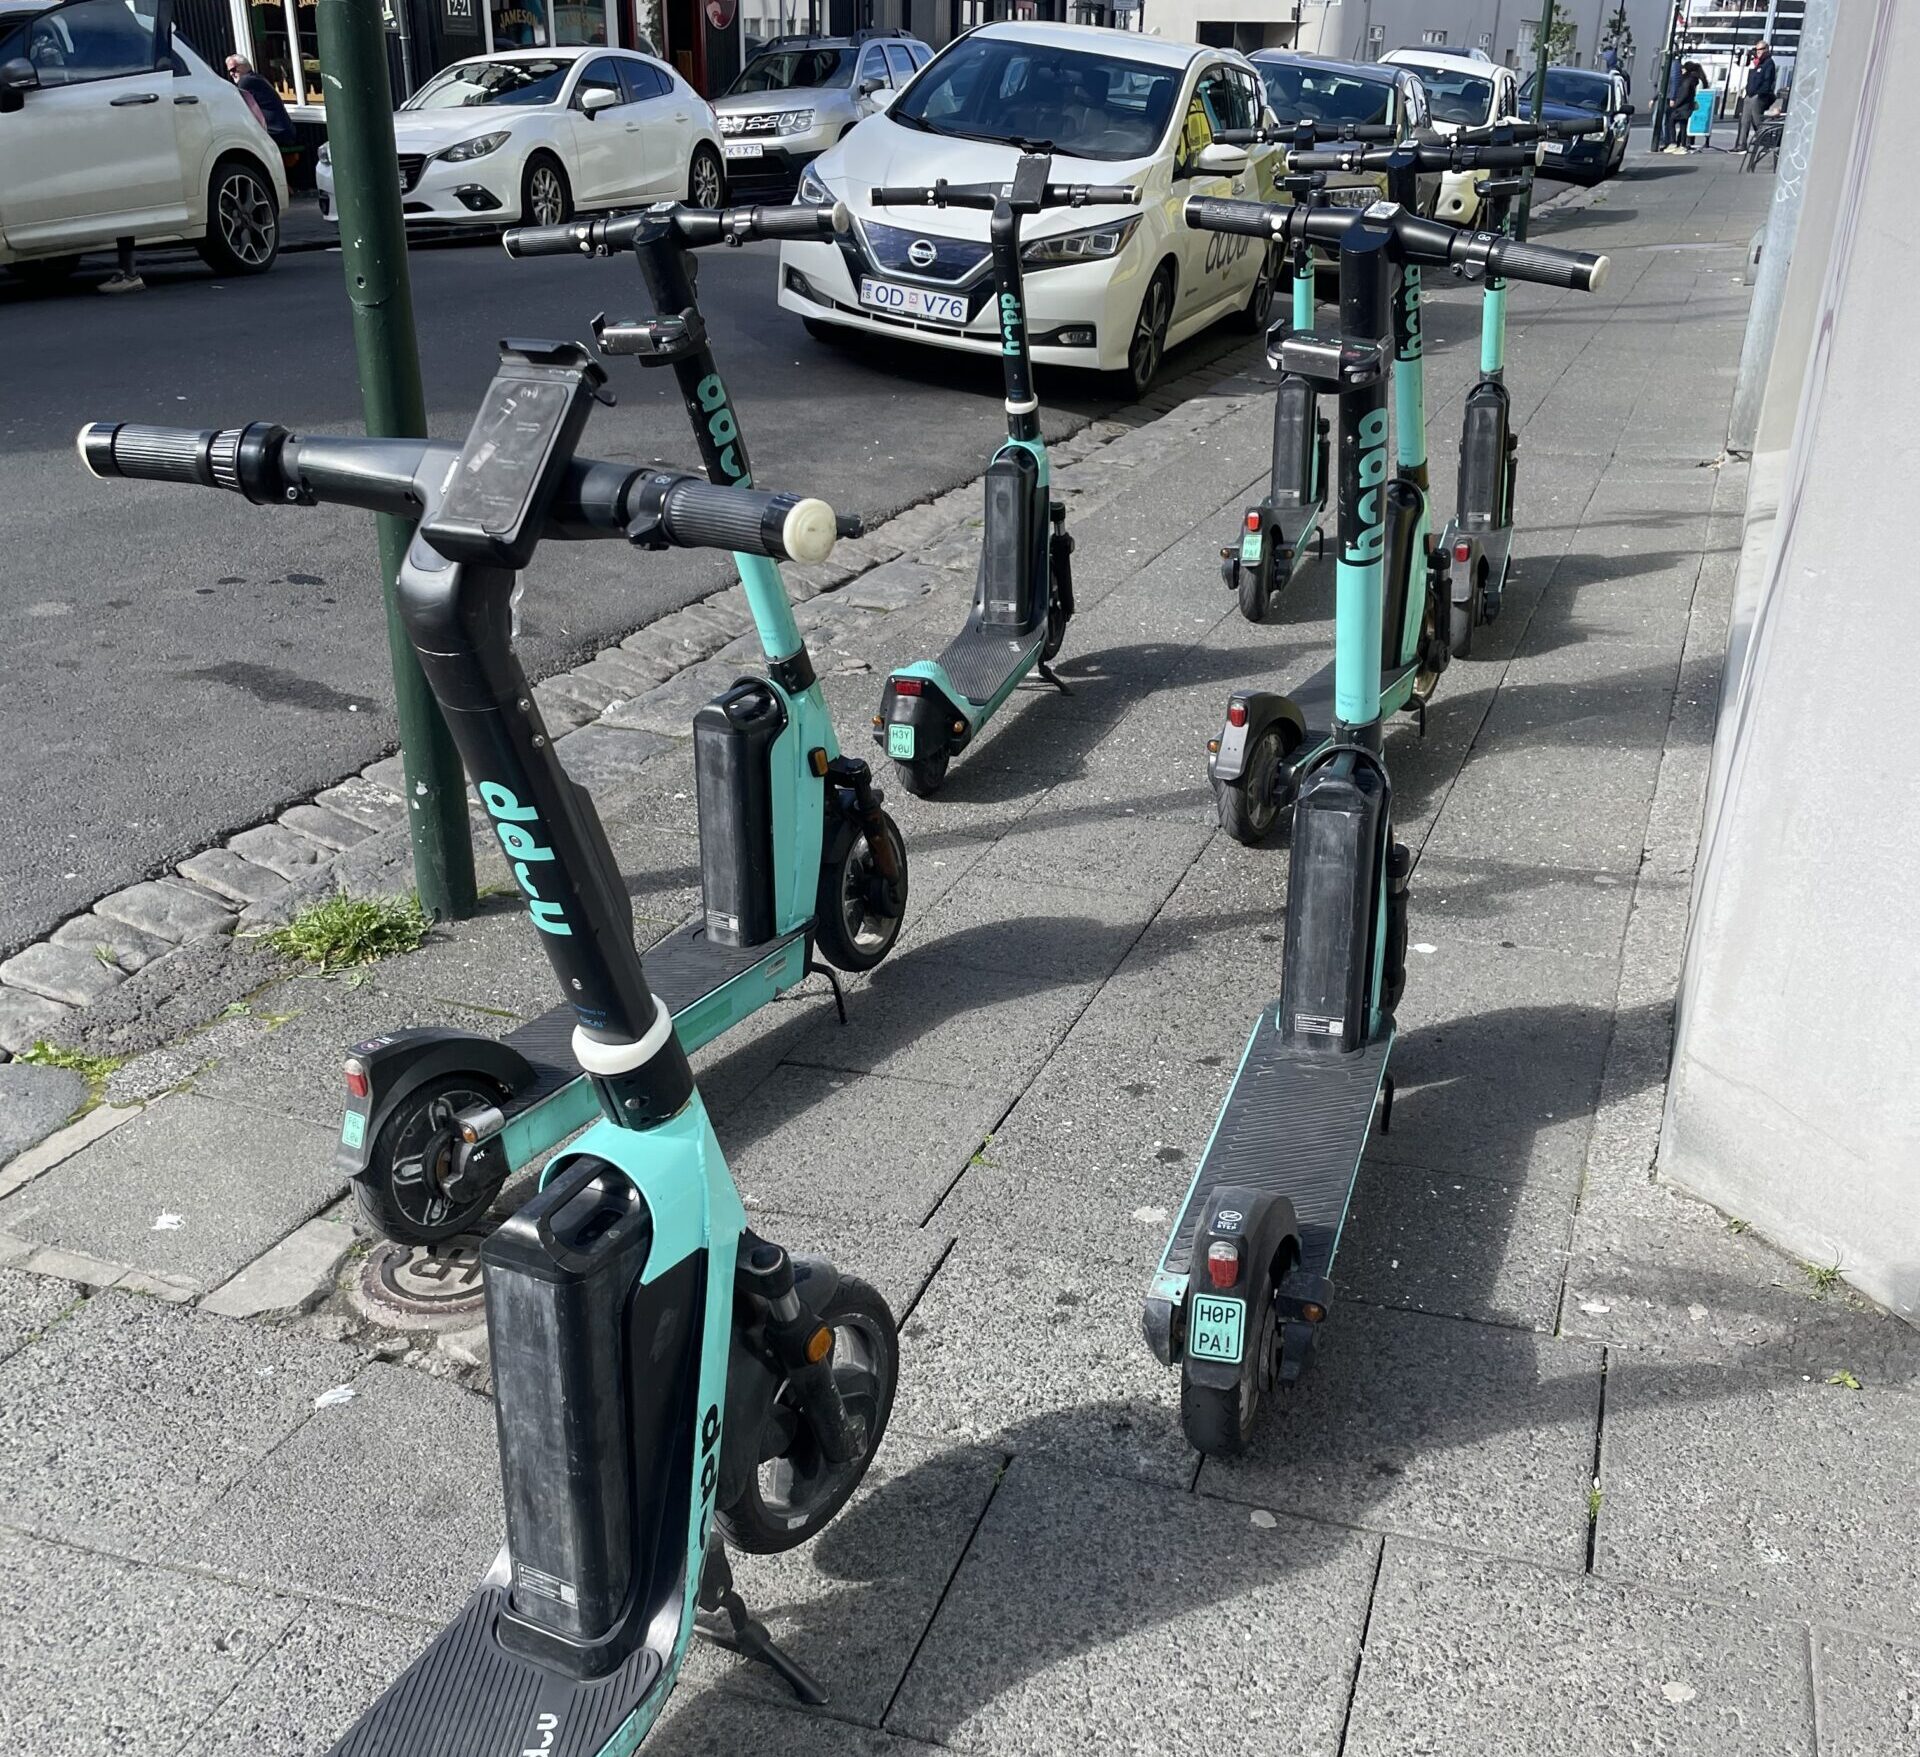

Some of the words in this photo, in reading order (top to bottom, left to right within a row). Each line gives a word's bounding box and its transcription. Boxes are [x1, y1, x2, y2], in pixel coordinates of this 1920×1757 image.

[743, 146, 761, 155] X75
[875, 285, 904, 306] OD
[923, 294, 963, 318] V76
[1198, 1333, 1230, 1353] PA!
